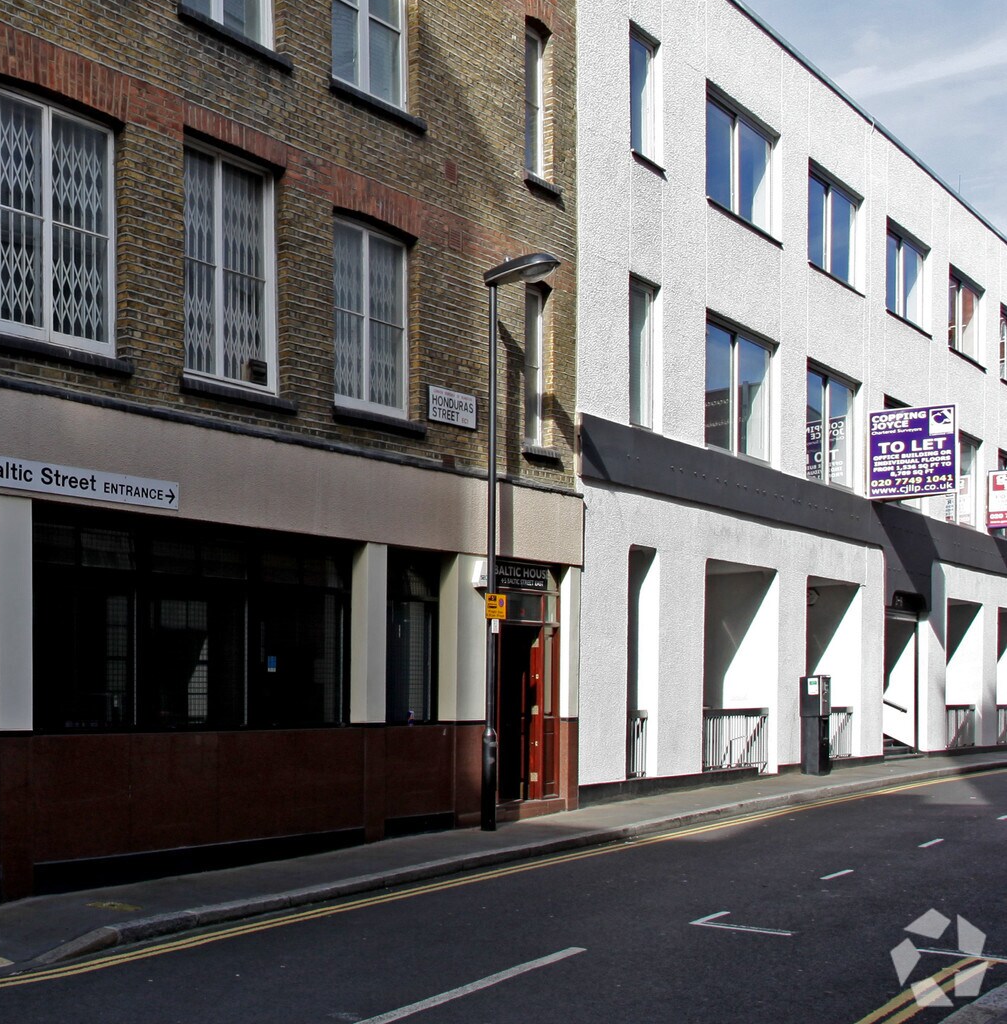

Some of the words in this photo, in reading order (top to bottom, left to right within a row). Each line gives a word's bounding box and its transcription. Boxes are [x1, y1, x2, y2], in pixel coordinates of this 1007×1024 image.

[432, 394, 474, 414] HONDURAS
[432, 406, 460, 422] STREET
[872, 411, 927, 423] COPPING
[871, 420, 909, 431] JOYCE
[878, 441, 905, 454] TO
[912, 437, 947, 452] LET
[901, 450, 939, 458] BUILDING
[874, 458, 920, 466] INDIVIDUAL
[40, 468, 96, 492] Street
[104, 482, 164, 500] ENTRANCE
[871, 479, 892, 487] 020
[895, 476, 922, 486] 7749
[926, 474, 954, 483] 1041
[872, 482, 952, 494] www.cjllp.co.uk
